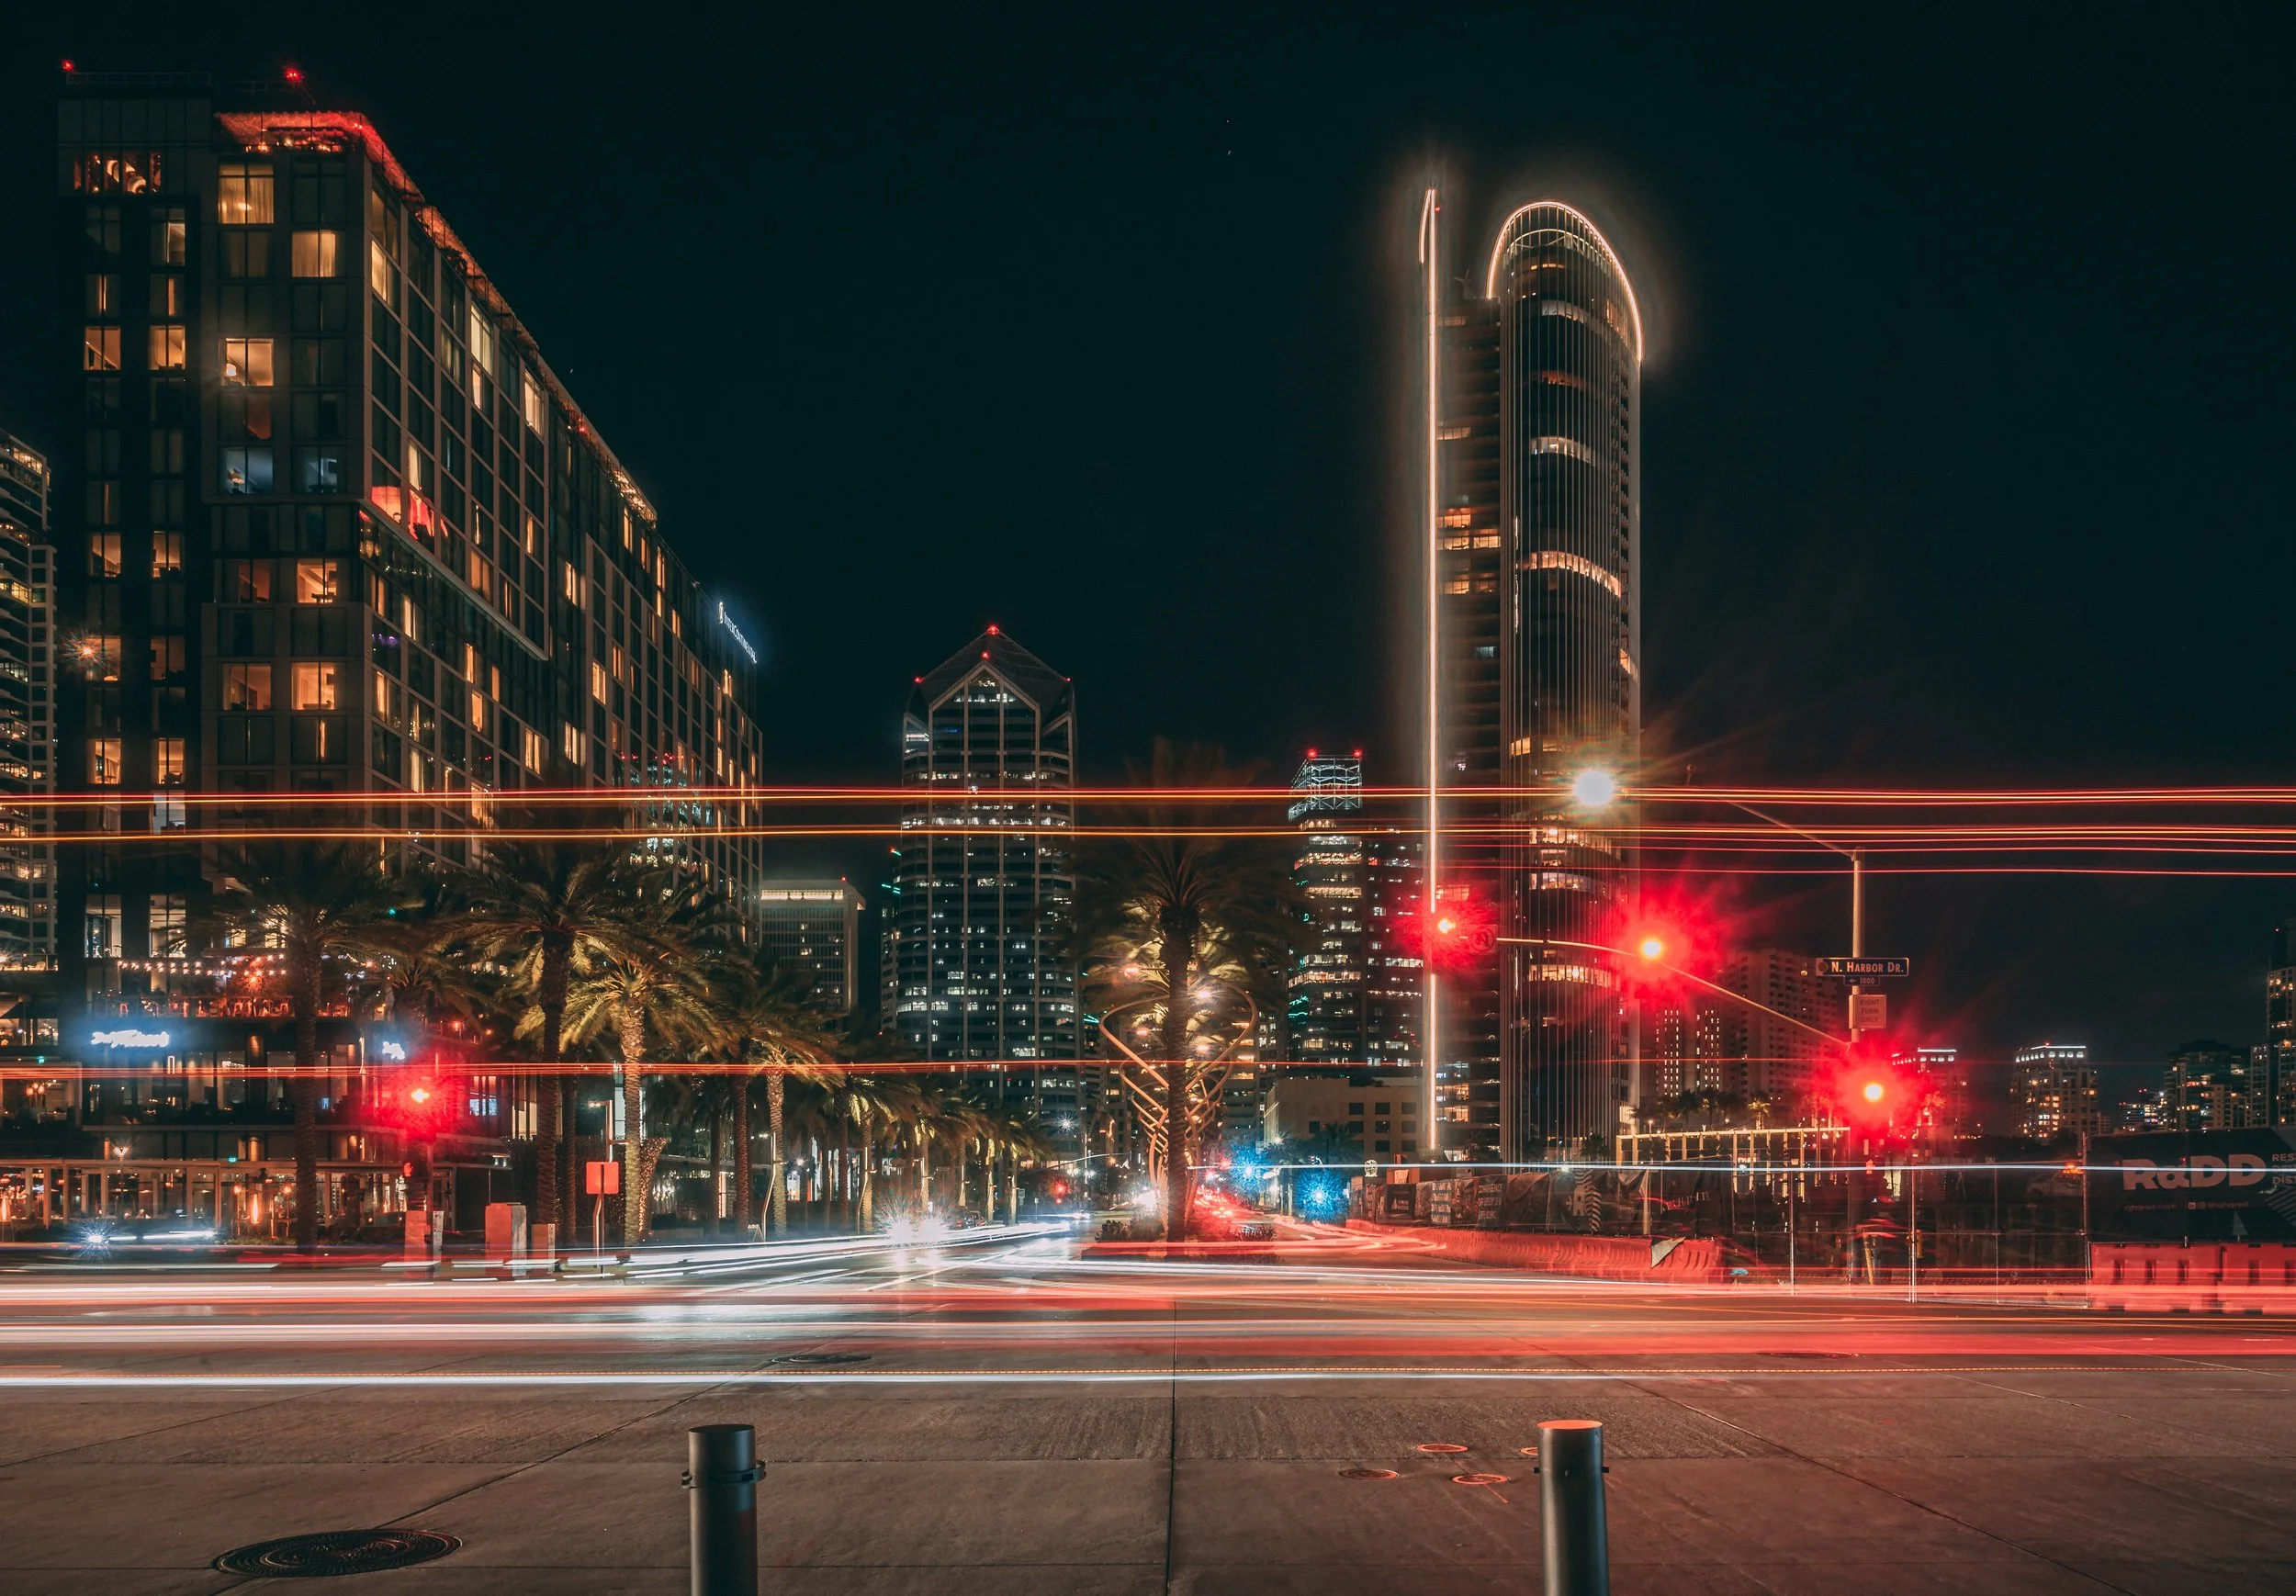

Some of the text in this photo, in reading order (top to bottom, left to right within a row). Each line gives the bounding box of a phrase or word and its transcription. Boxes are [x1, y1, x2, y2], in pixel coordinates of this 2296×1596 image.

[1831, 961, 1904, 972] N. HARBOR DR.
[2271, 1153, 2296, 1162] RES
